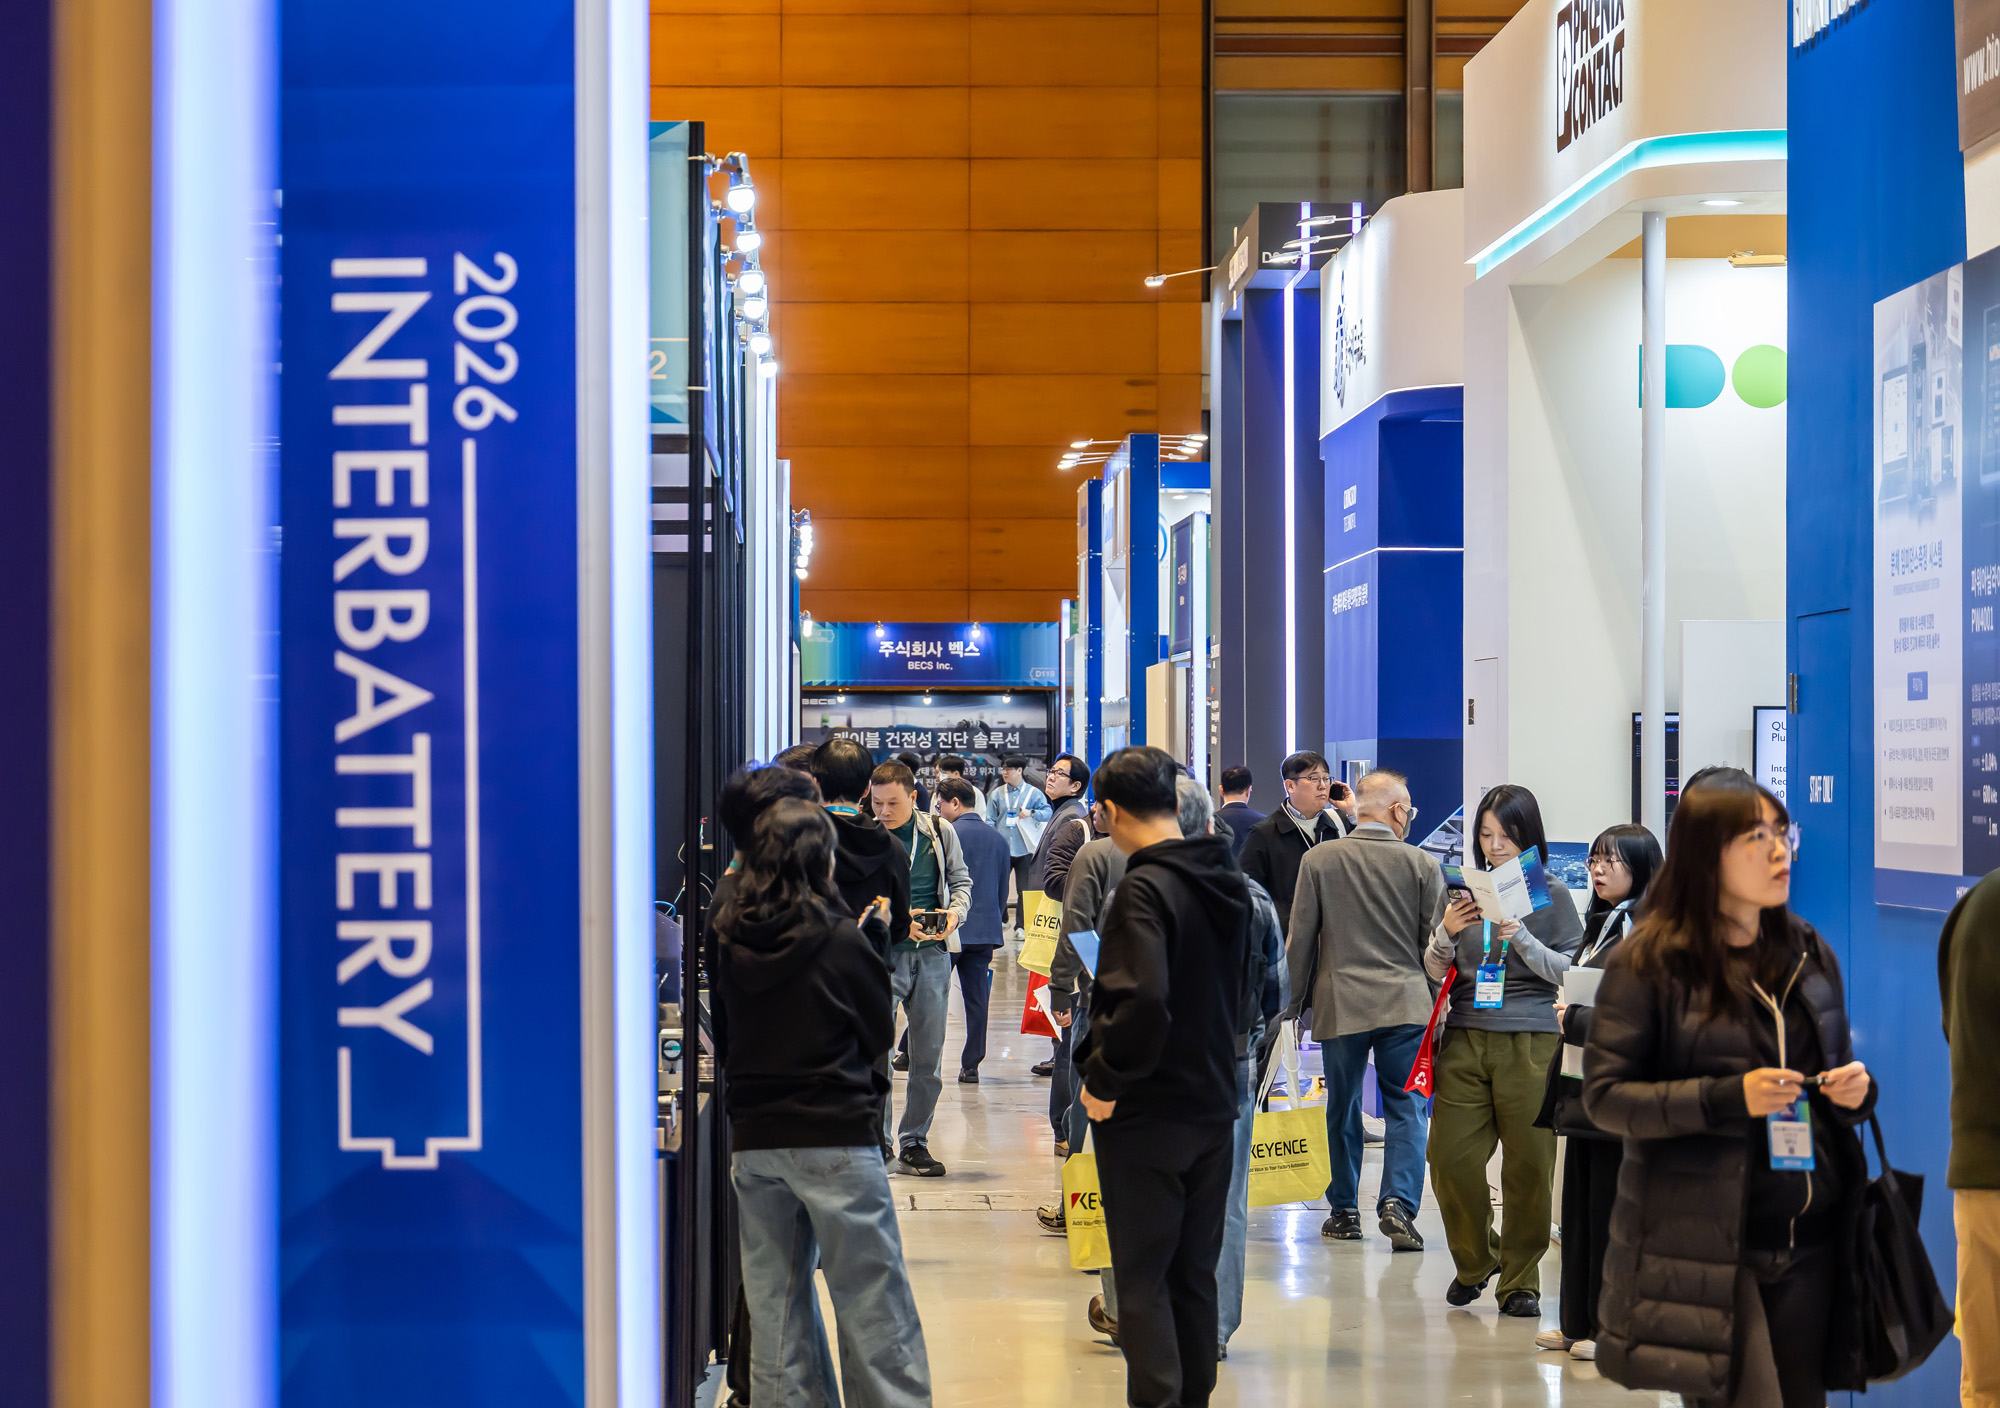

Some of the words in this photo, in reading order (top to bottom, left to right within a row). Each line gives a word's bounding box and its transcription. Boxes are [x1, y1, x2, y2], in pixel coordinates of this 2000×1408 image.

[1573, 28, 1625, 140] CONTACT
[452, 251, 520, 431] 2026
[1971, 605, 1994, 633] PW4001
[328, 256, 435, 1056] INTERBATTERY
[878, 640, 944, 659] 주식회사
[948, 640, 981, 659] 벡스
[907, 661, 934, 671] BECS
[936, 661, 954, 671] Inc.
[885, 731, 932, 749] 건전성
[936, 731, 968, 749] 진단
[972, 731, 1021, 749] 솔루션
[1809, 775, 1822, 803] STAFF
[1822, 775, 1834, 803] ONLY
[1250, 1139, 1308, 1158] KEYENCE
